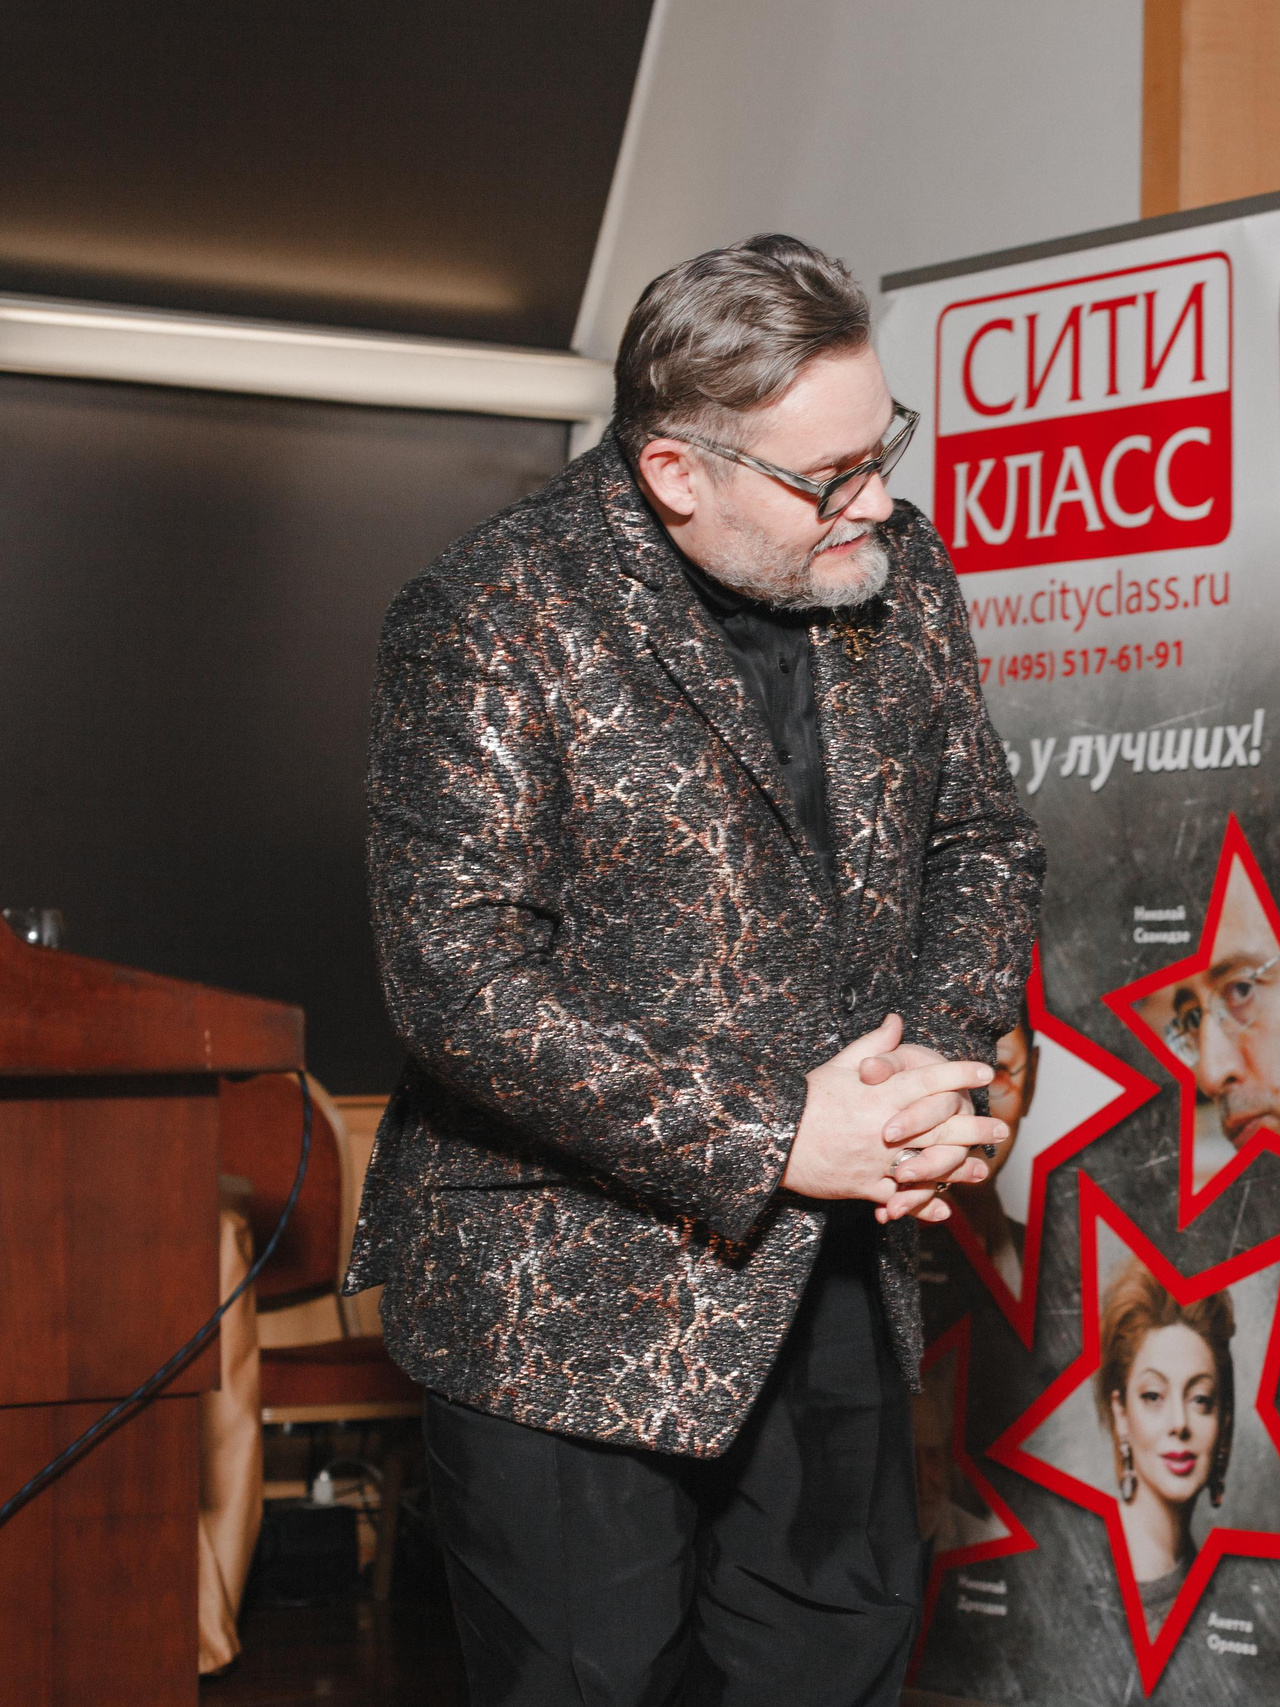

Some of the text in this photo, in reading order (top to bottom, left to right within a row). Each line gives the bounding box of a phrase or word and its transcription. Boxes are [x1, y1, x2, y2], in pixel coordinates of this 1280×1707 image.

[962, 282, 1207, 417] СИТИ
[952, 426, 1214, 549] КЛАСС
[998, 652, 1055, 687] (495)
[1062, 640, 1183, 677] 517-61-91
[1026, 737, 1056, 796] у
[1060, 708, 1265, 792] лучших!
